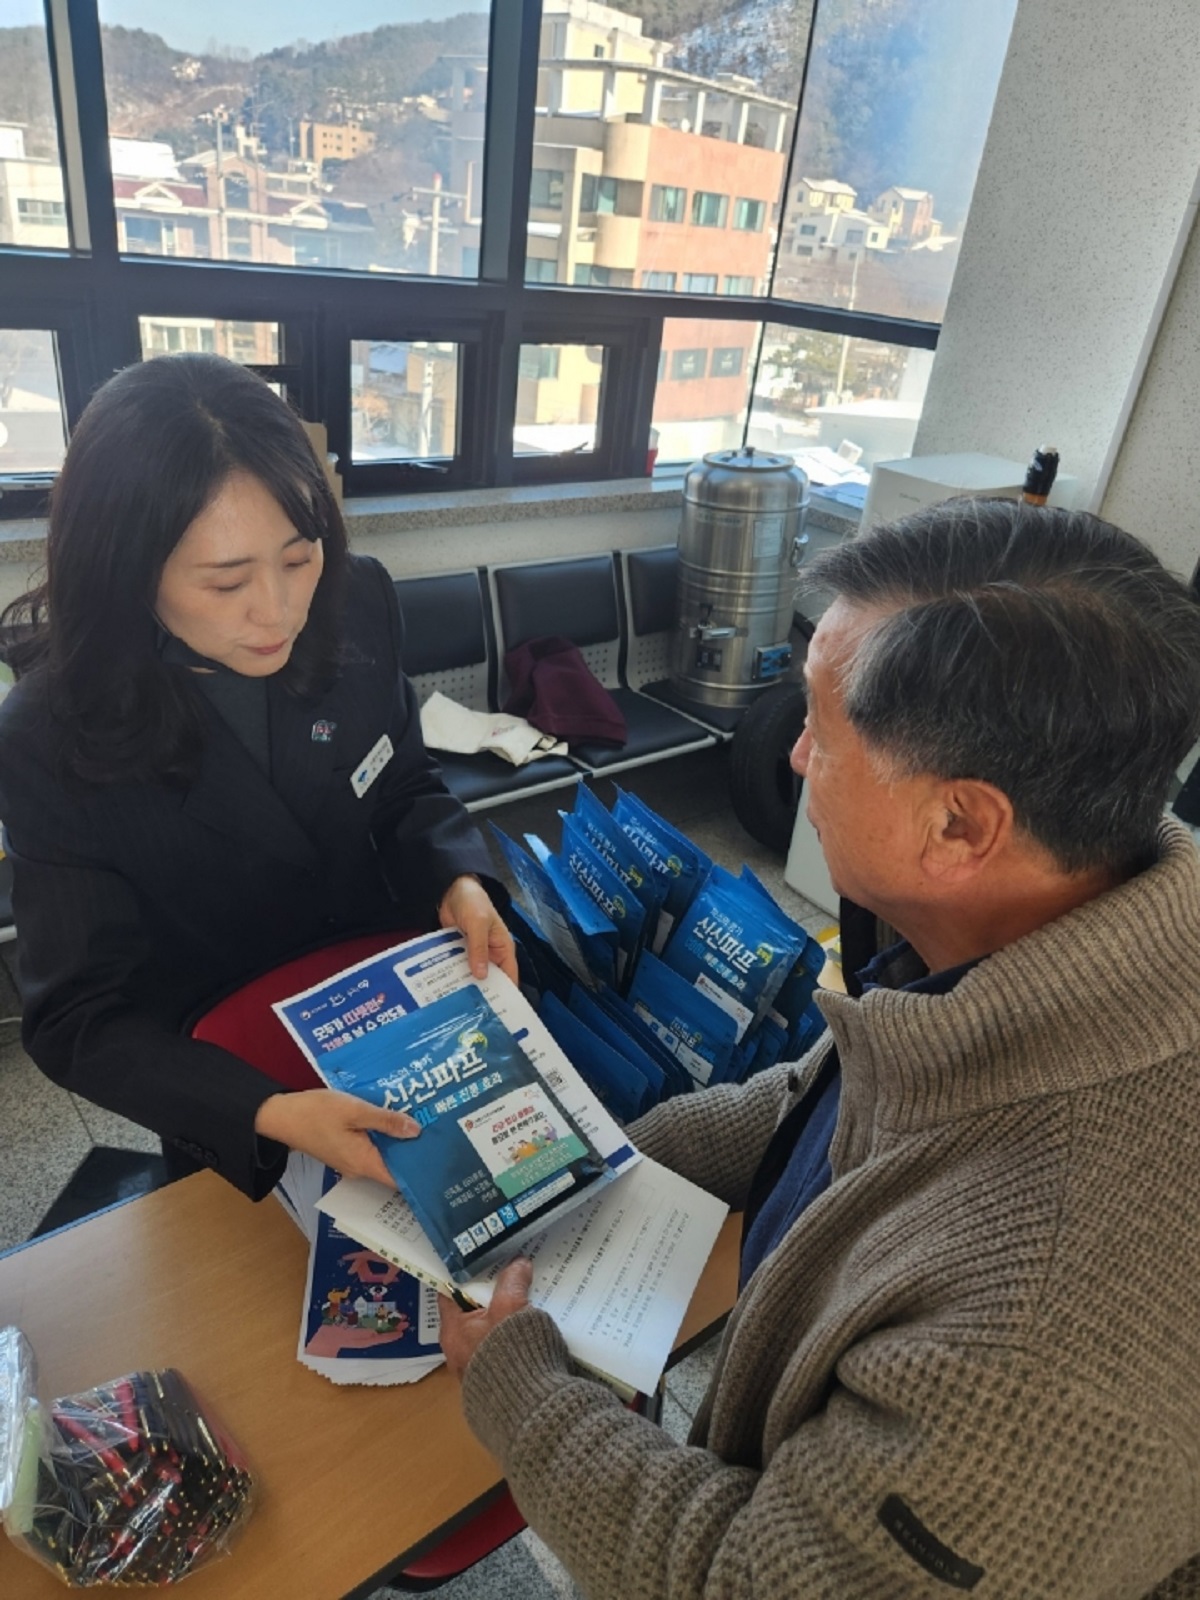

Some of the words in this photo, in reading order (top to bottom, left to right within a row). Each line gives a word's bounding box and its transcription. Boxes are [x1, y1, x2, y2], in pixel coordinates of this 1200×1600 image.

[693, 916, 758, 974] 신신파프
[312, 1017, 345, 1042] 모두가
[382, 1046, 488, 1113] 신신파프
[482, 1071, 503, 1091] 효과
